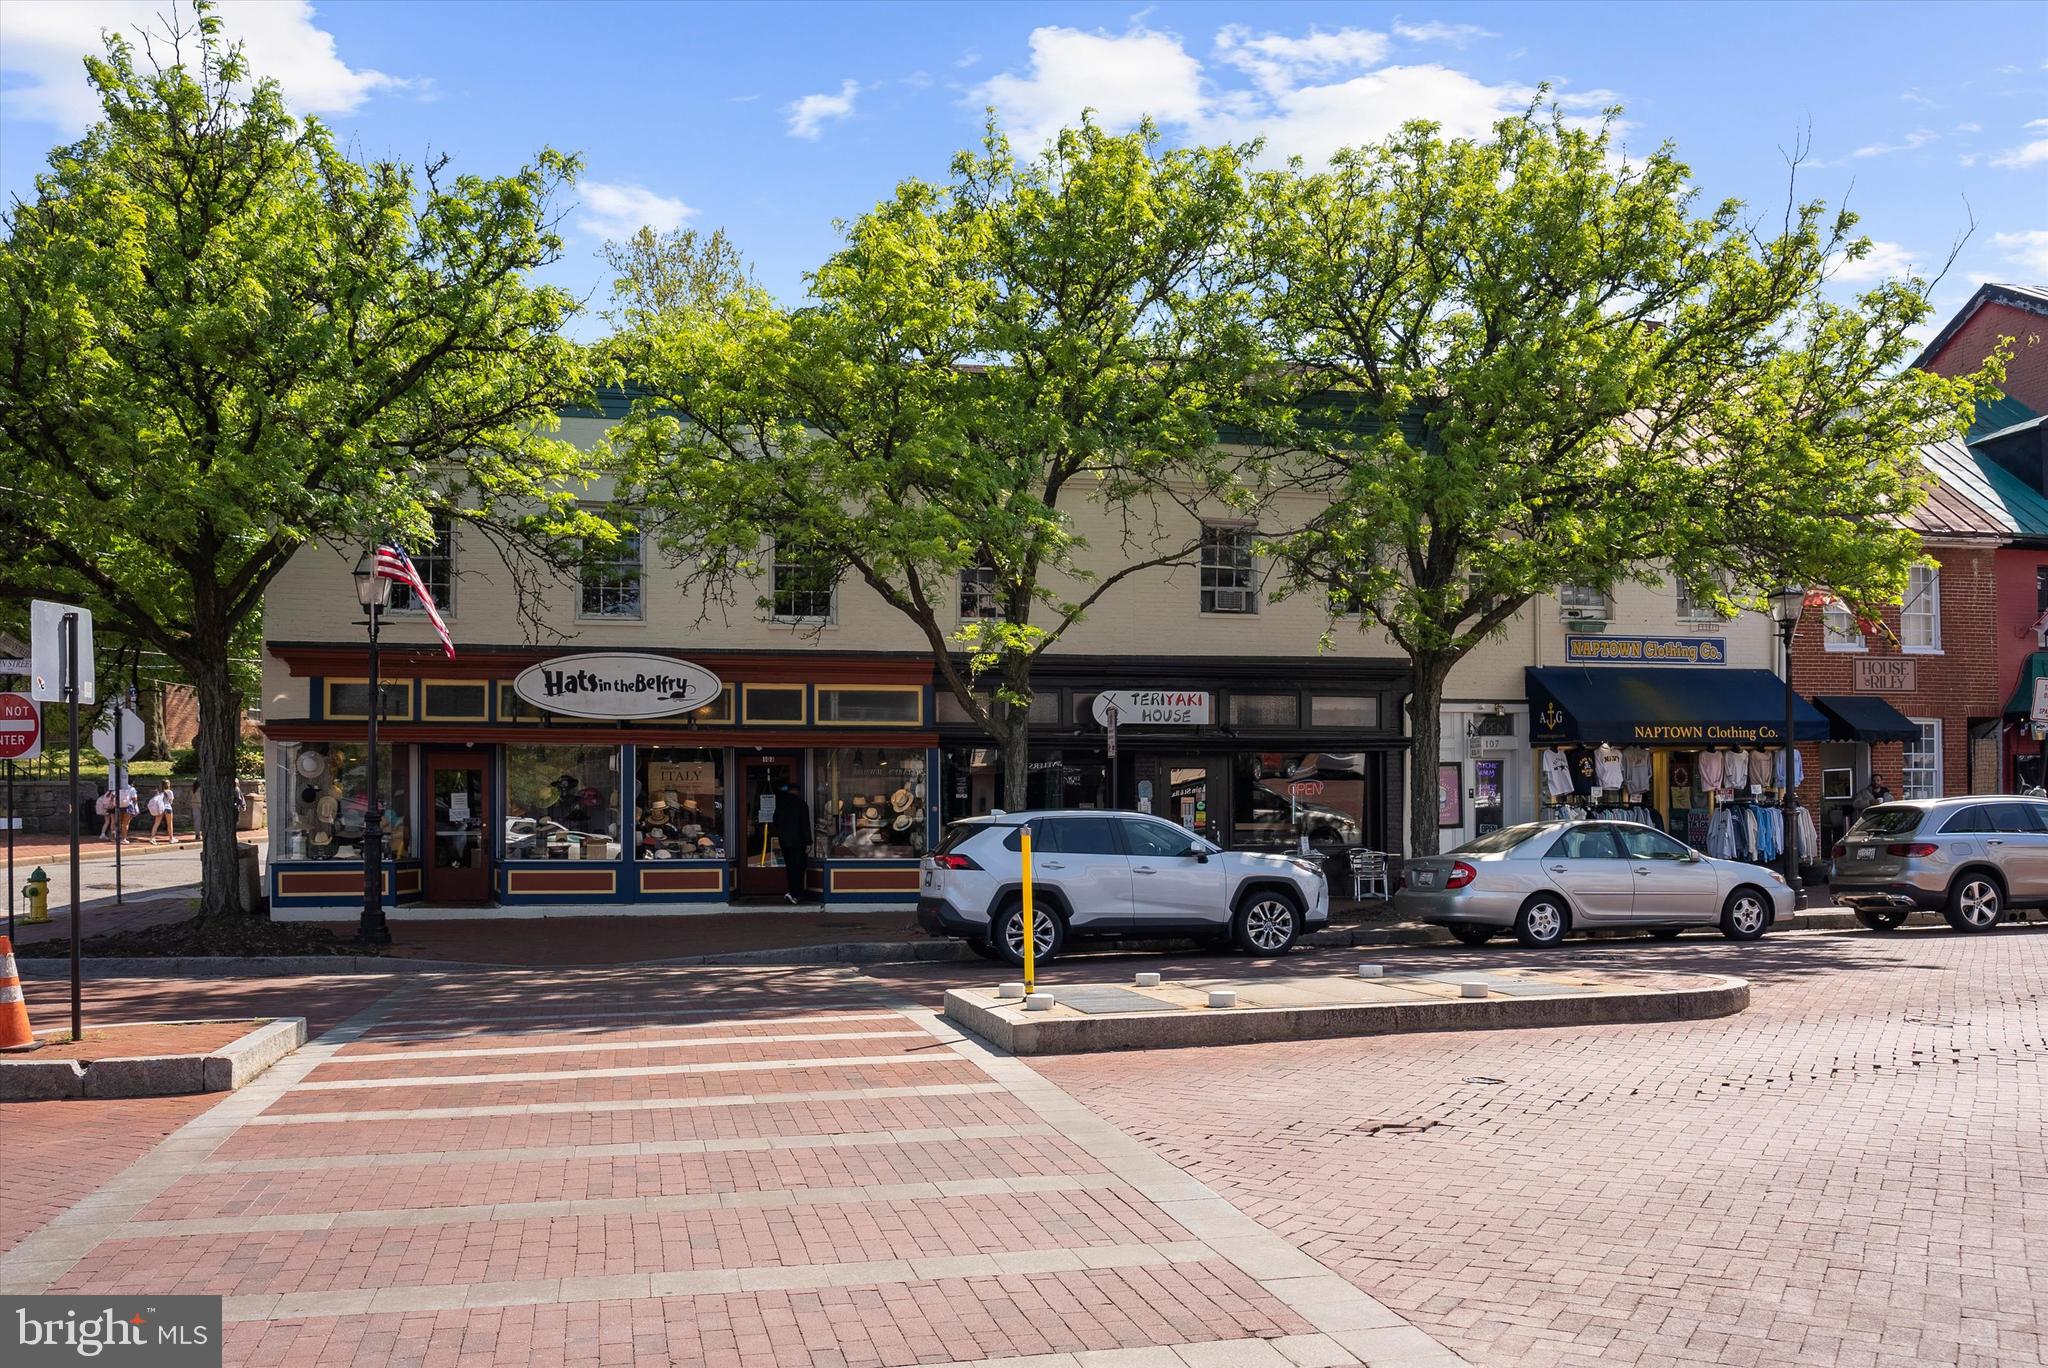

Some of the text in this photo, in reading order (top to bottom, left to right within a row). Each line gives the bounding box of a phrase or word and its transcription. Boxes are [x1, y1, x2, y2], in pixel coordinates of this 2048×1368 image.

[1571, 640, 1722, 662] NAPTOWN Clothing Co.
[1862, 661, 1910, 675] HOUSE
[543, 670, 688, 696] Hats in the Belfry
[1870, 675, 1906, 689] RILEY
[1131, 692, 1203, 706] TERIYAKI
[5, 706, 29, 717] NOT
[1142, 709, 1191, 723] HOUSE
[1634, 726, 1778, 741] NAPTOWN Clothing Co.
[1485, 740, 1499, 748] 107
[661, 770, 702, 781] ITALY
[1288, 783, 1323, 796] OPEN
